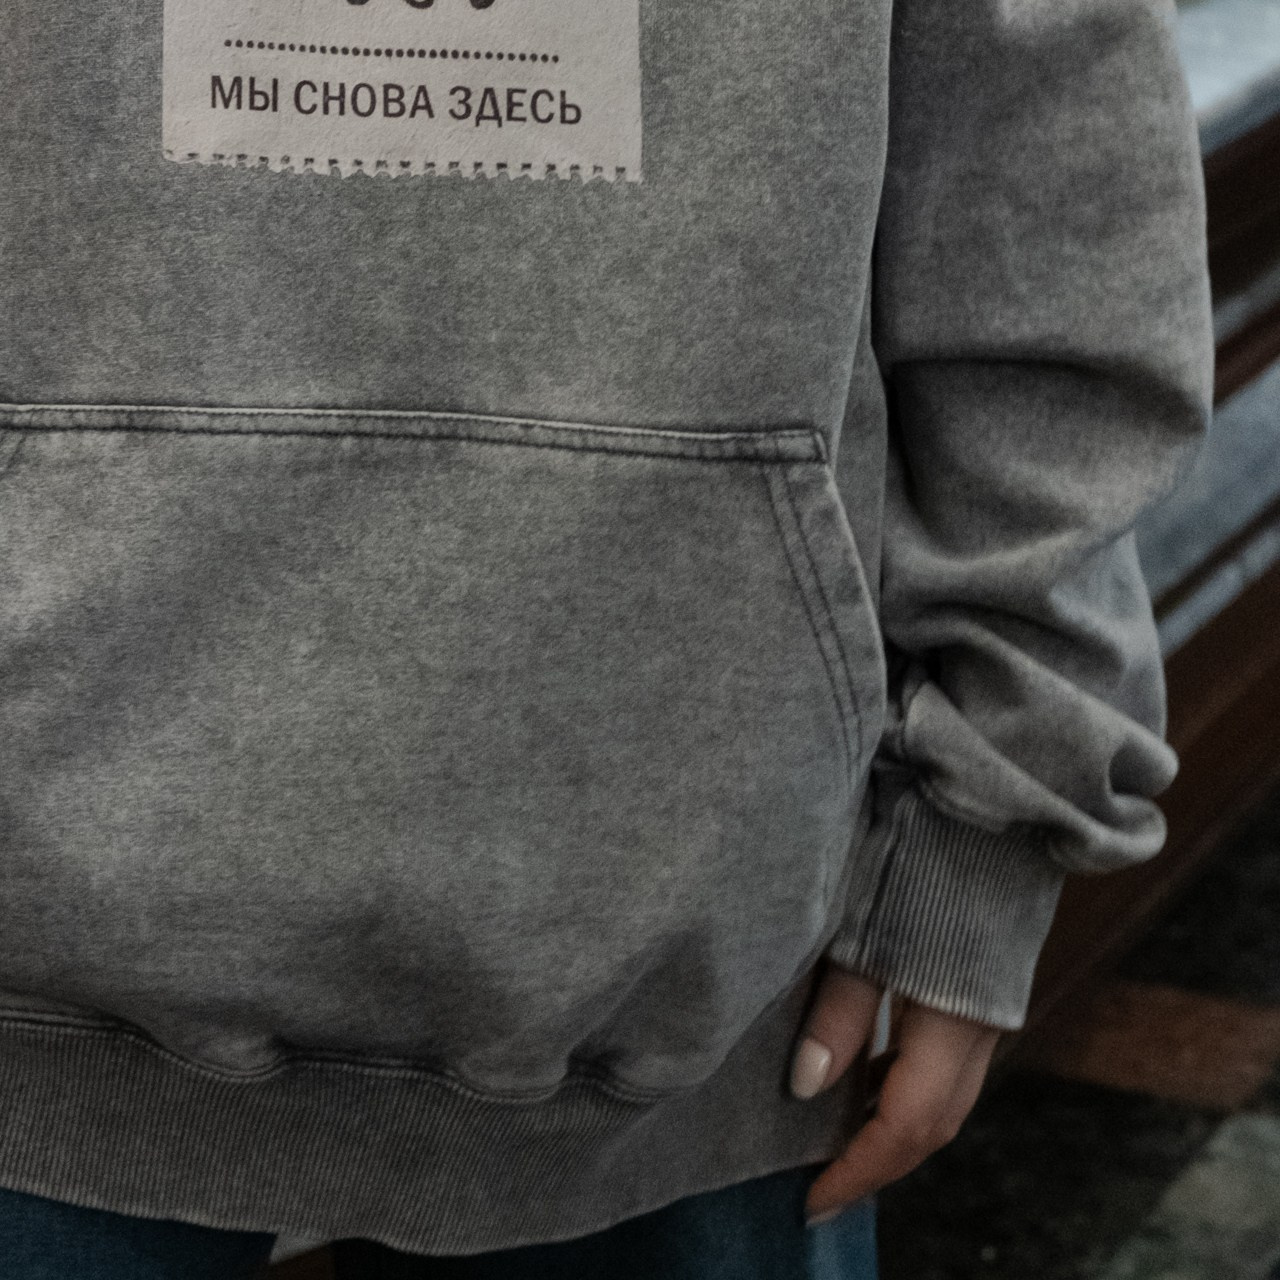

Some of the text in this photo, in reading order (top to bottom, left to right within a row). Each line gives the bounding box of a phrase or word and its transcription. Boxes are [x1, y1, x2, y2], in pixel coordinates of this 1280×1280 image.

[210, 74, 583, 129] МЫ СНОВА ЗДЕСЬ
